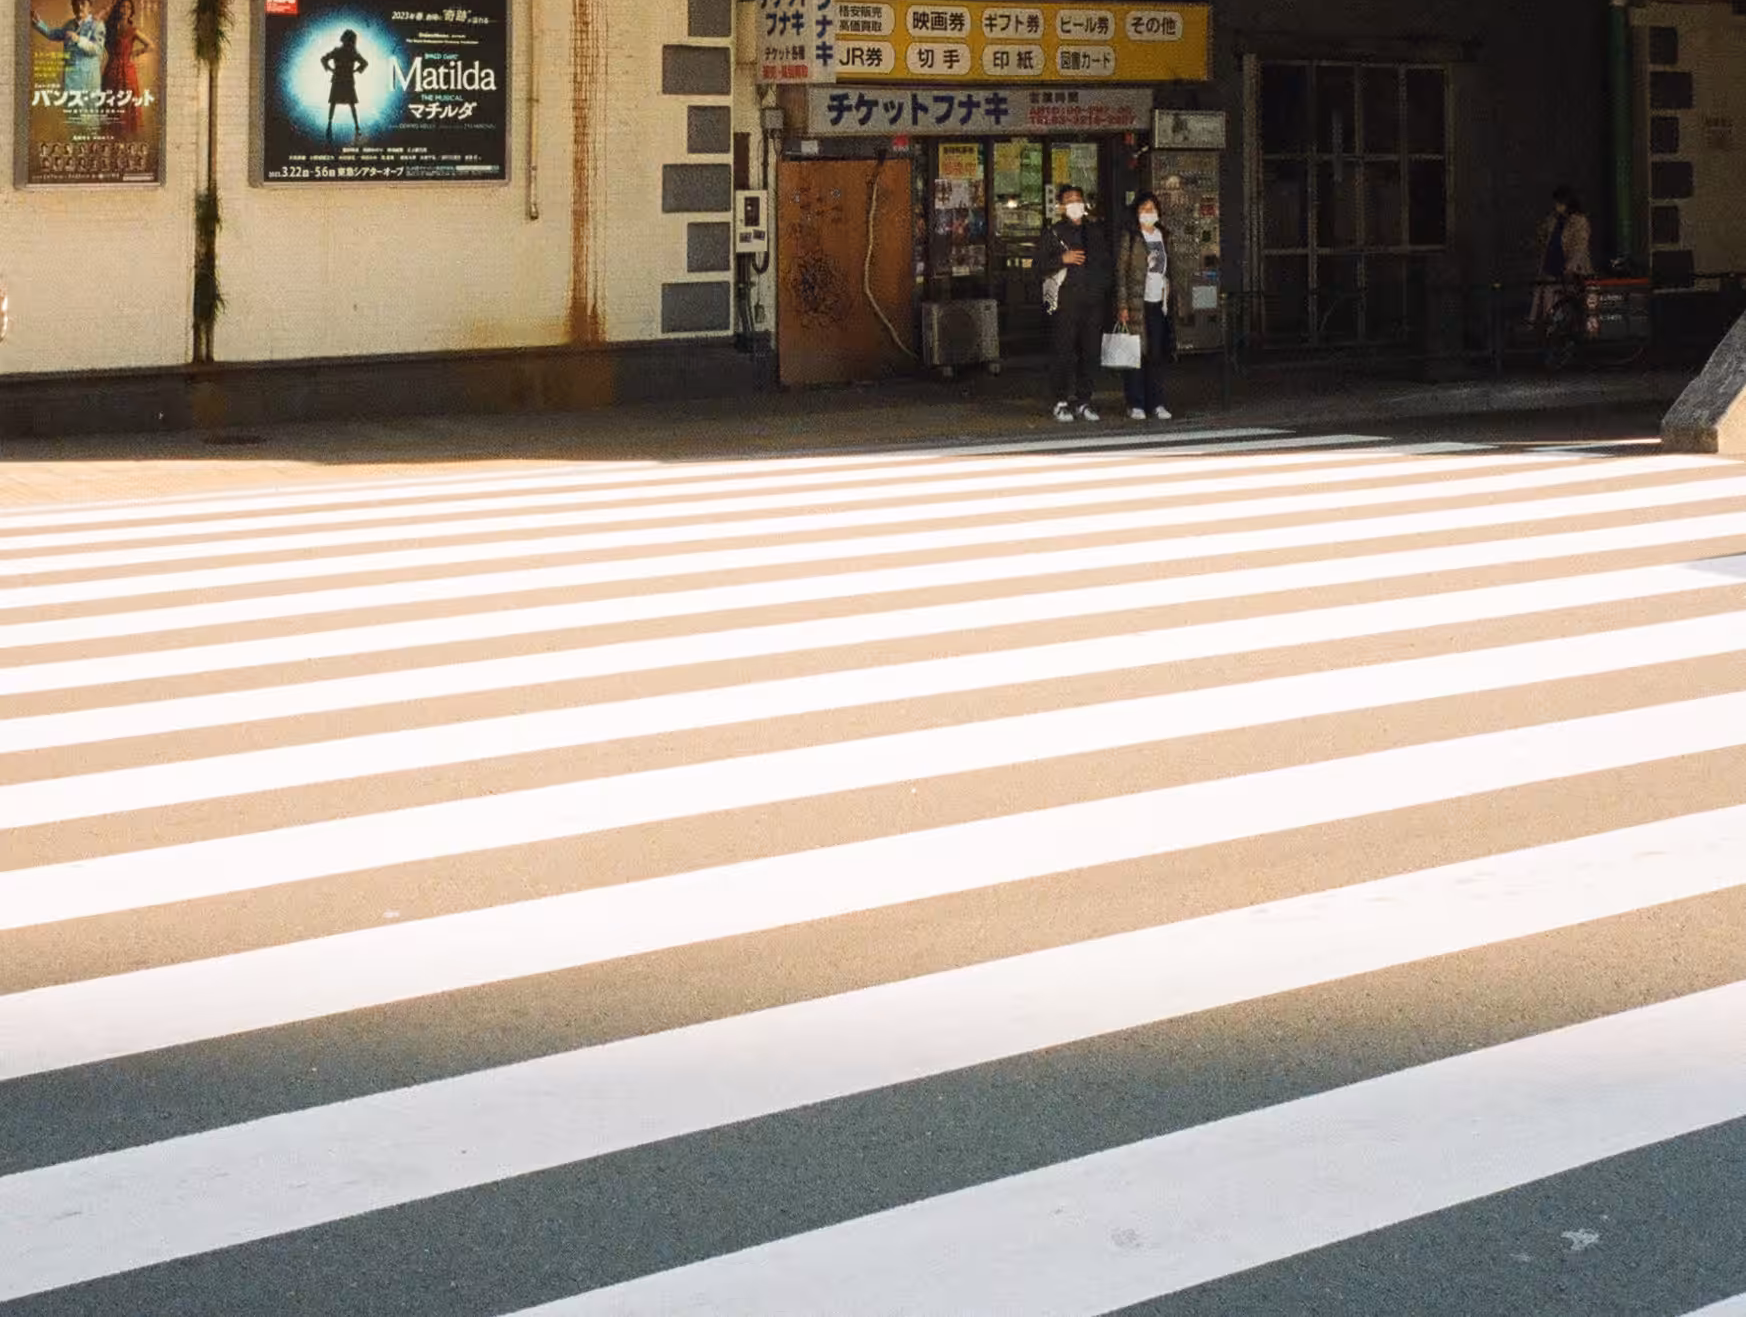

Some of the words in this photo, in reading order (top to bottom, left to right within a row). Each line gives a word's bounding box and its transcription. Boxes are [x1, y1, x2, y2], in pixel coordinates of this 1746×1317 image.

[765, 8, 805, 37] フナキ
[912, 11, 966, 32] 映画券
[984, 13, 1040, 34] ギフト券
[1060, 16, 1110, 35] ビール券
[1130, 16, 1179, 36] その他
[838, 47, 884, 67] JR券
[1060, 51, 1111, 71] 図書カード
[388, 55, 497, 92] Matilda
[31, 88, 155, 108] バンズ・ヴィジット
[408, 101, 478, 120] マチルダ
[827, 92, 1009, 126] チケットフナキ
